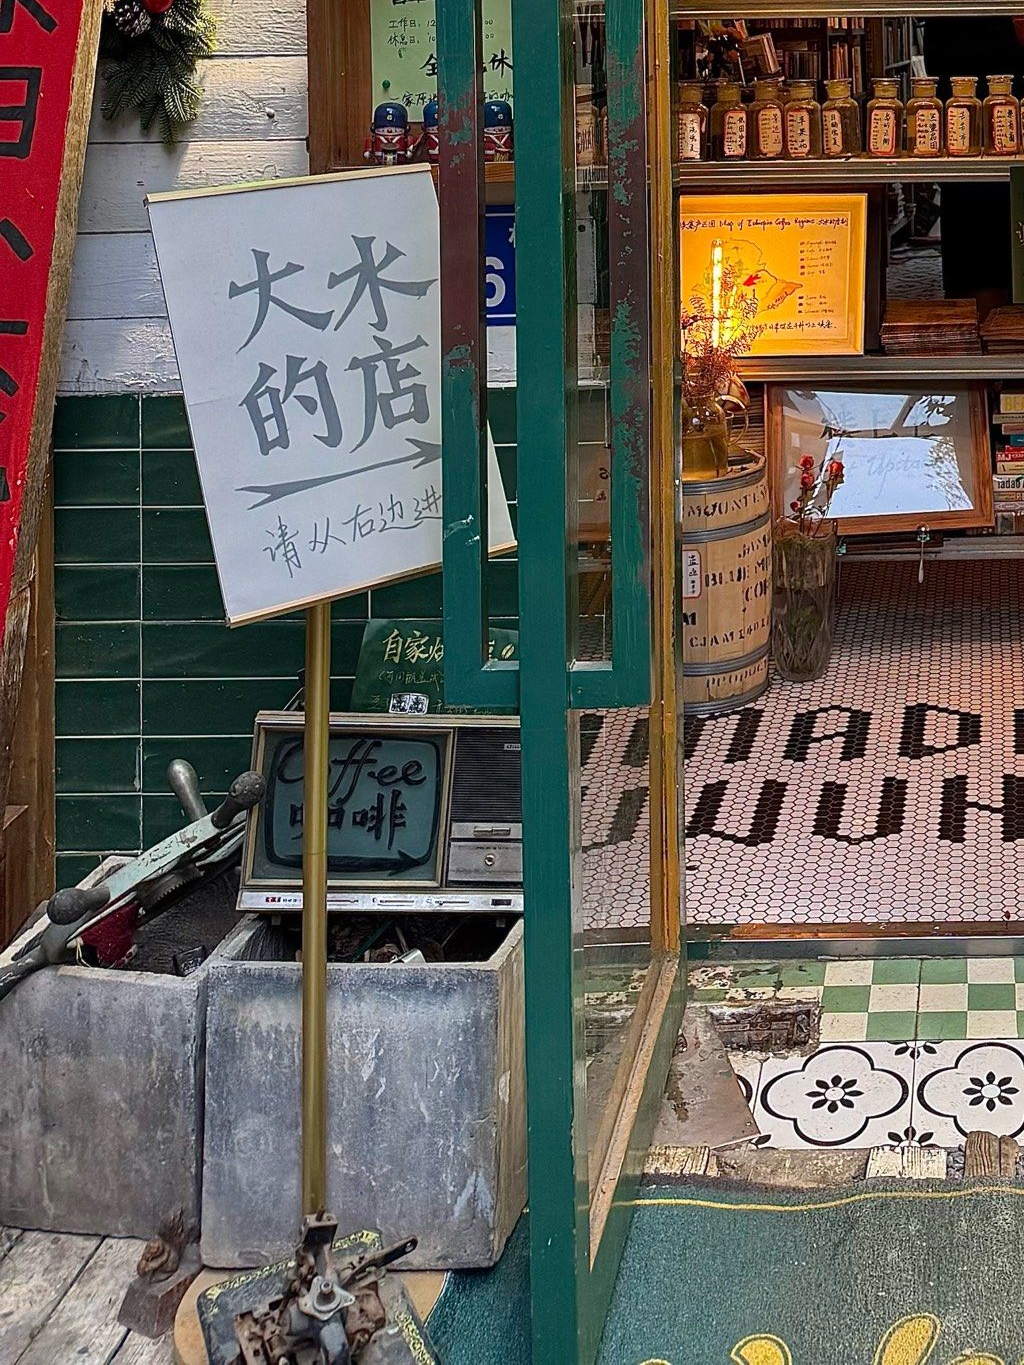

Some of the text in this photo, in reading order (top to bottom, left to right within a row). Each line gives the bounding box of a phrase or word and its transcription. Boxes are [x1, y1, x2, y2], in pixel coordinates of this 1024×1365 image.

[228, 235, 438, 352] 大水
[239, 335, 430, 455] 的店
[277, 738, 427, 805] Cffee
